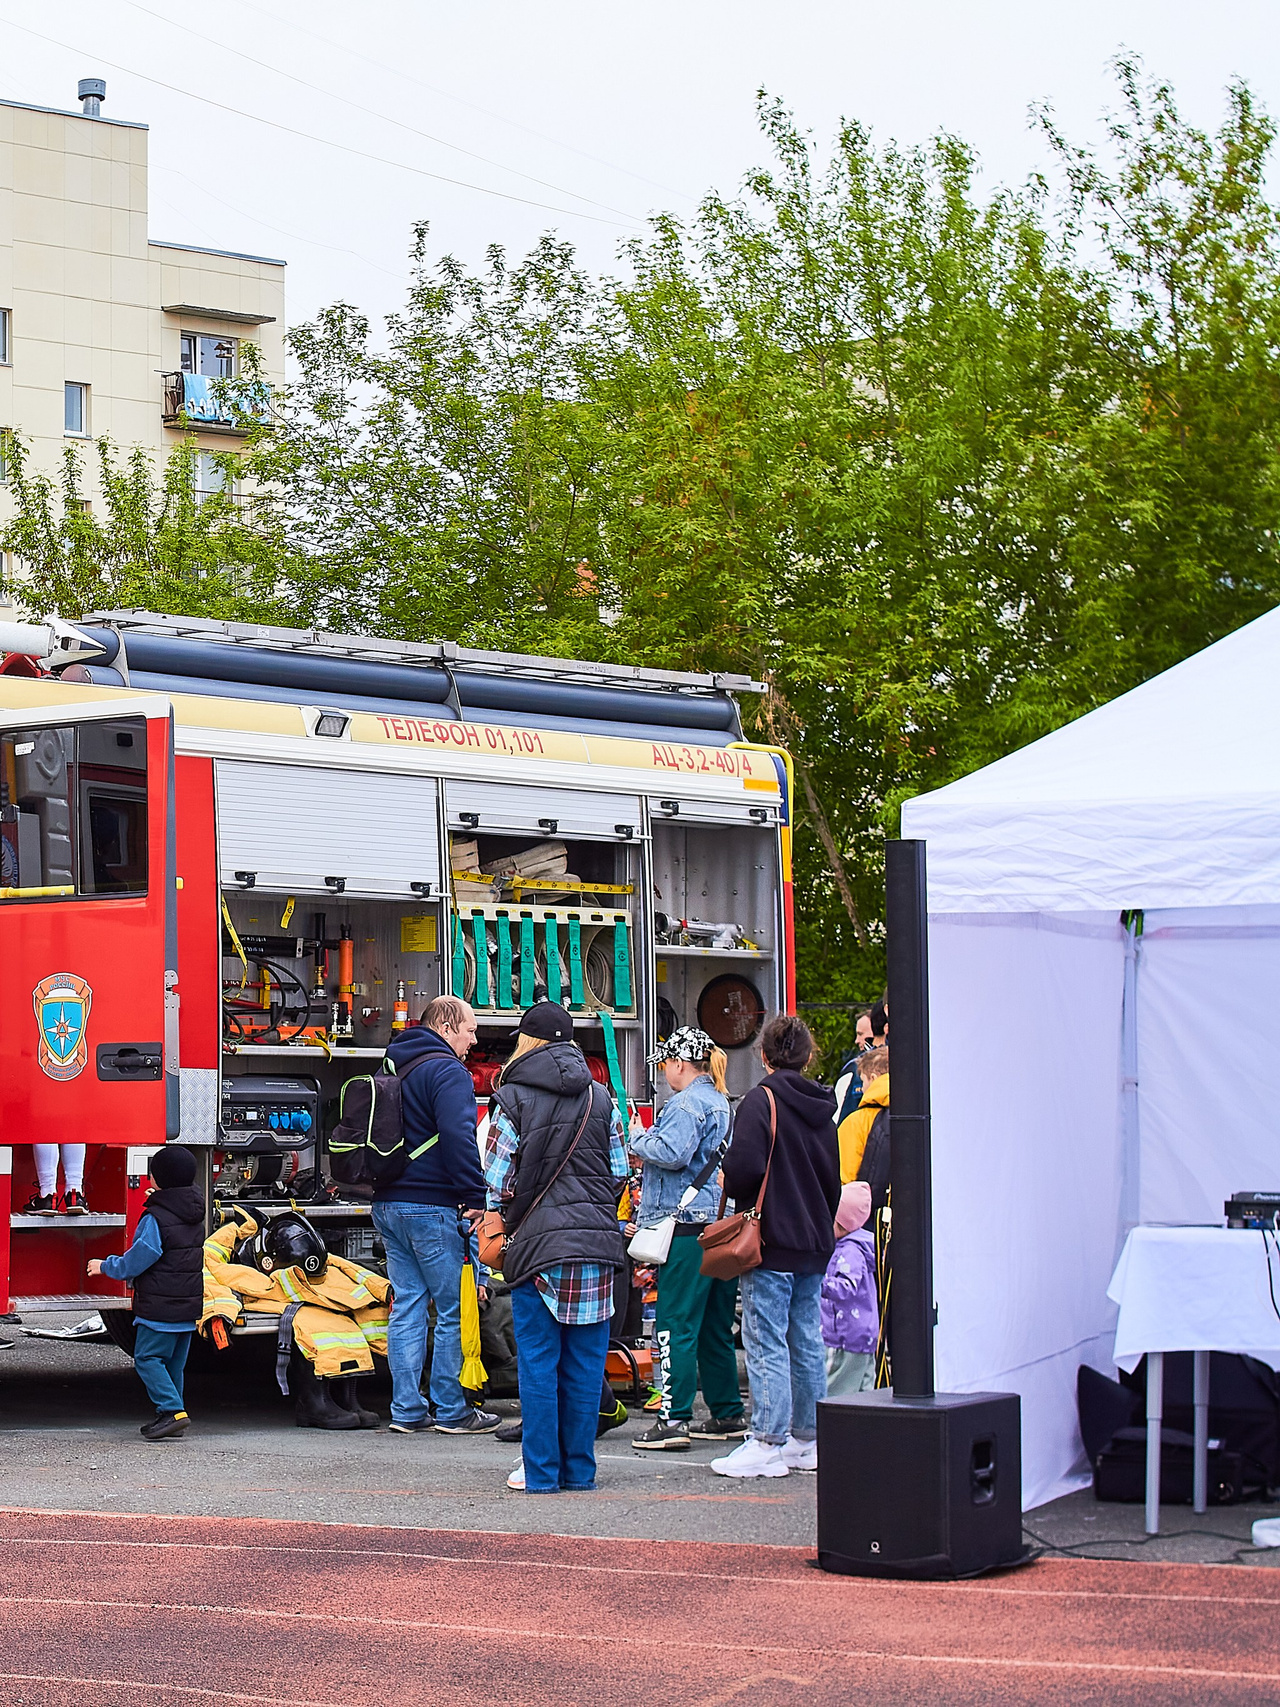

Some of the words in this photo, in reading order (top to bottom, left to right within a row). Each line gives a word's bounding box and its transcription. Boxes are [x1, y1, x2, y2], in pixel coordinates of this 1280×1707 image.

[376, 717, 480, 747] ТЕЛЕФОН
[486, 727, 545, 755] 01,101
[651, 744, 753, 776] АЦ-3,2-40/4
